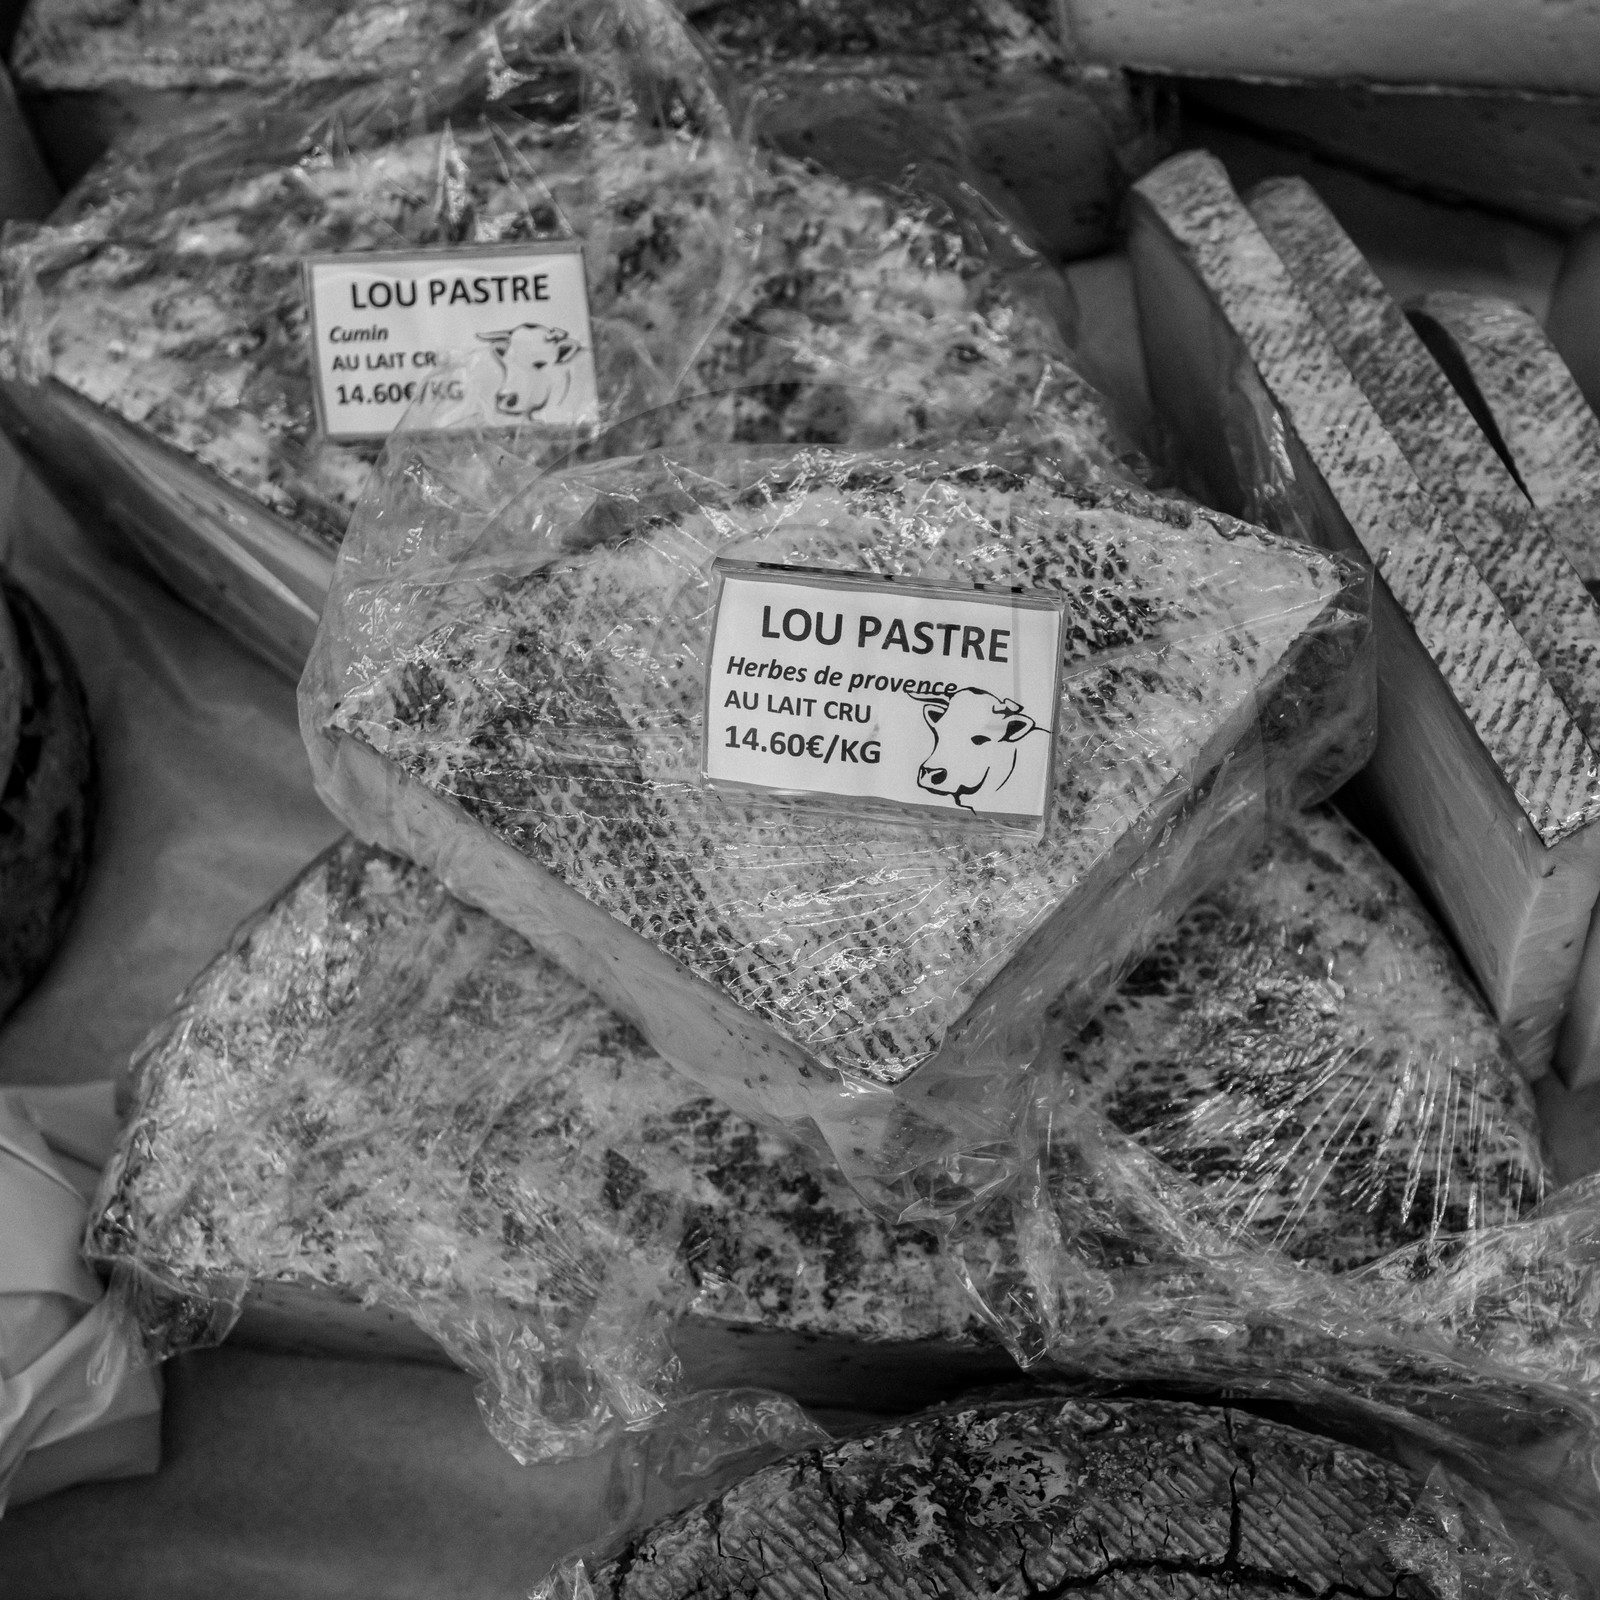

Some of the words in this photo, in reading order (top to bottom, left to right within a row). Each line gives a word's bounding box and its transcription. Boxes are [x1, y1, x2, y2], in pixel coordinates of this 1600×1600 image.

[352, 279, 417, 309] LOU
[429, 273, 550, 306] PASTRE
[329, 324, 389, 344] Cumin
[332, 354, 359, 371] AU
[366, 352, 406, 370] LAIT
[412, 350, 444, 368] CR
[336, 380, 464, 405] 14.60€/KG
[761, 605, 844, 646] LOU
[857, 615, 1012, 663] PASTRE
[726, 656, 807, 683] Herbes
[813, 665, 843, 687] de
[847, 674, 958, 696] provence
[724, 690, 759, 711] AU
[766, 694, 818, 717] LAIT
[823, 701, 872, 724] CRU
[724, 725, 882, 765] 14.60€/KG
